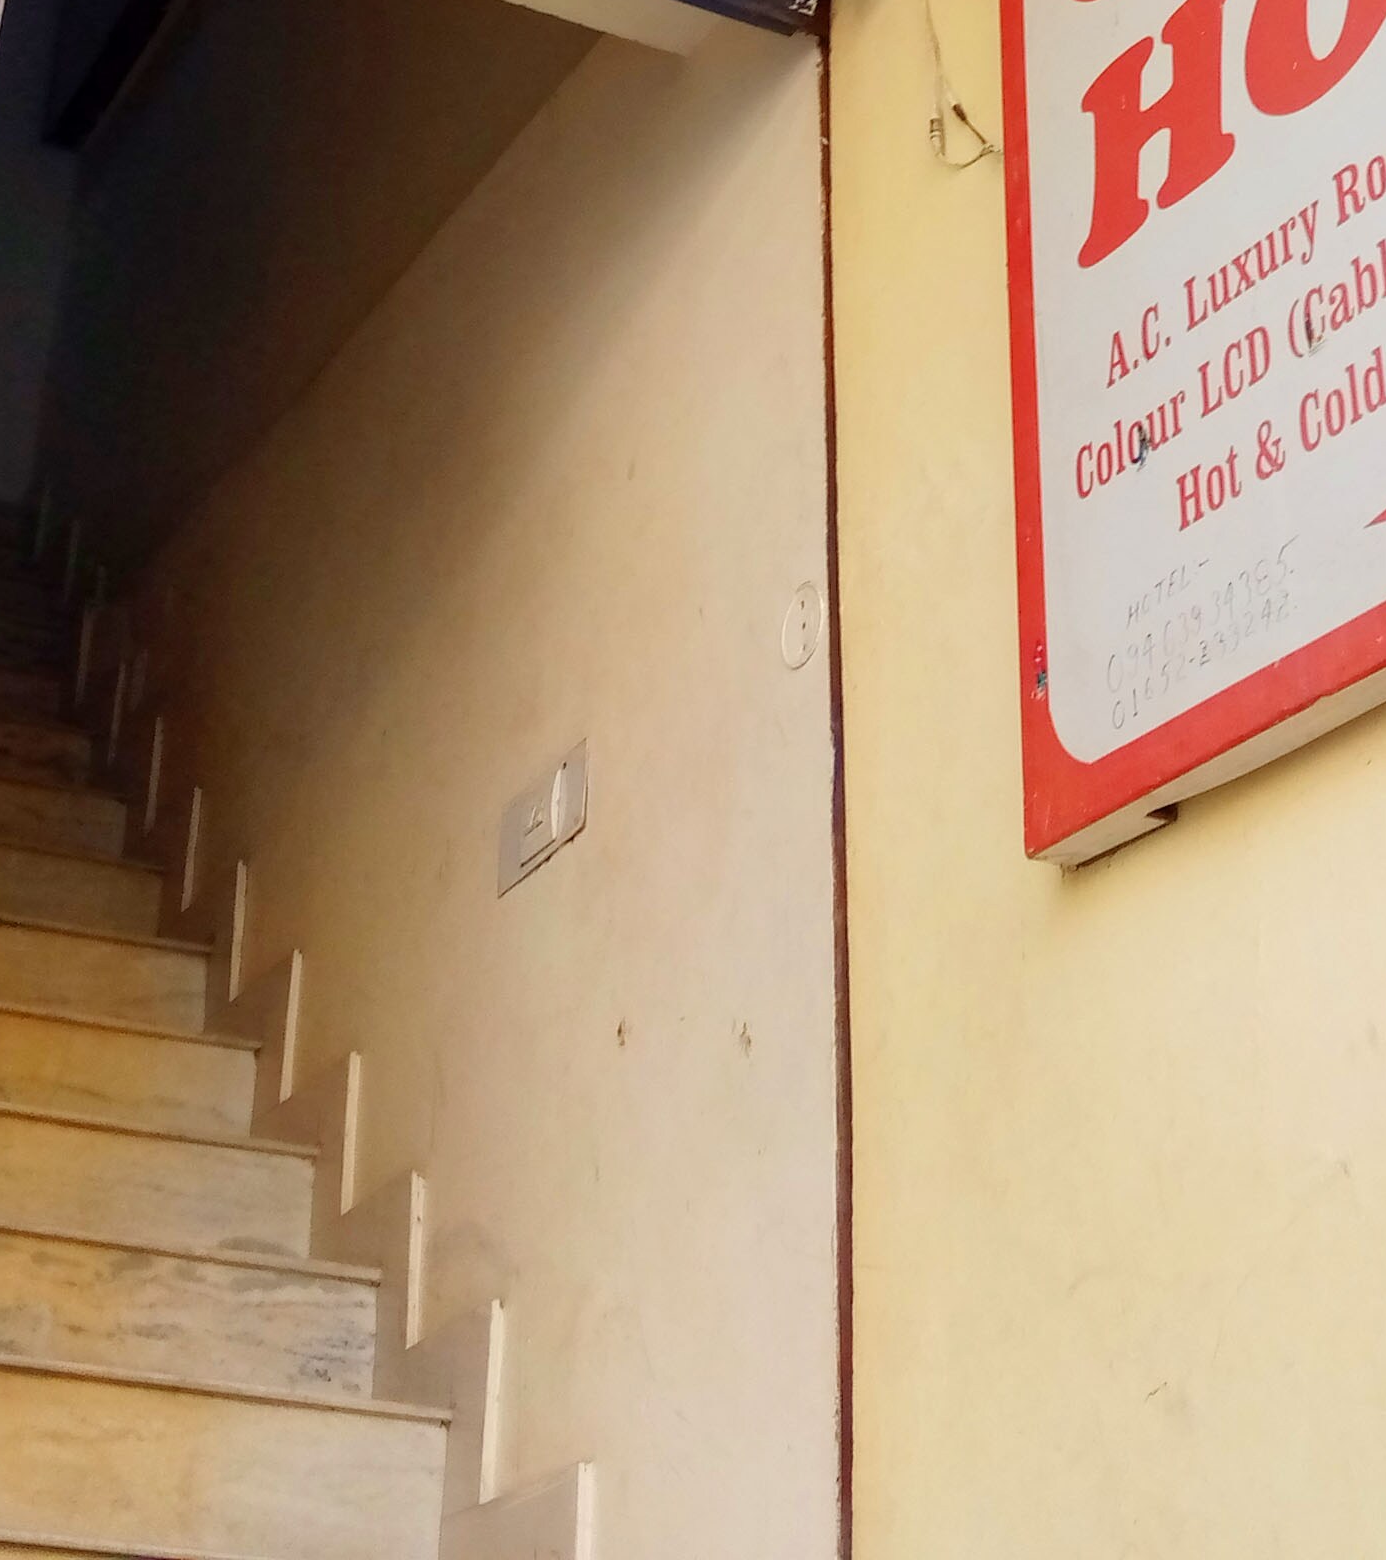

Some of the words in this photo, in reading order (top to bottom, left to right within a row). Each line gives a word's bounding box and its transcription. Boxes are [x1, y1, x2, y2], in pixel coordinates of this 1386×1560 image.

[1106, 304, 1171, 388] A.C.
[1184, 200, 1318, 331] Luxury
[1076, 390, 1186, 500] Colour
[1198, 326, 1271, 419] LCD
[1176, 446, 1242, 532] Hot
[1255, 420, 1287, 481] &
